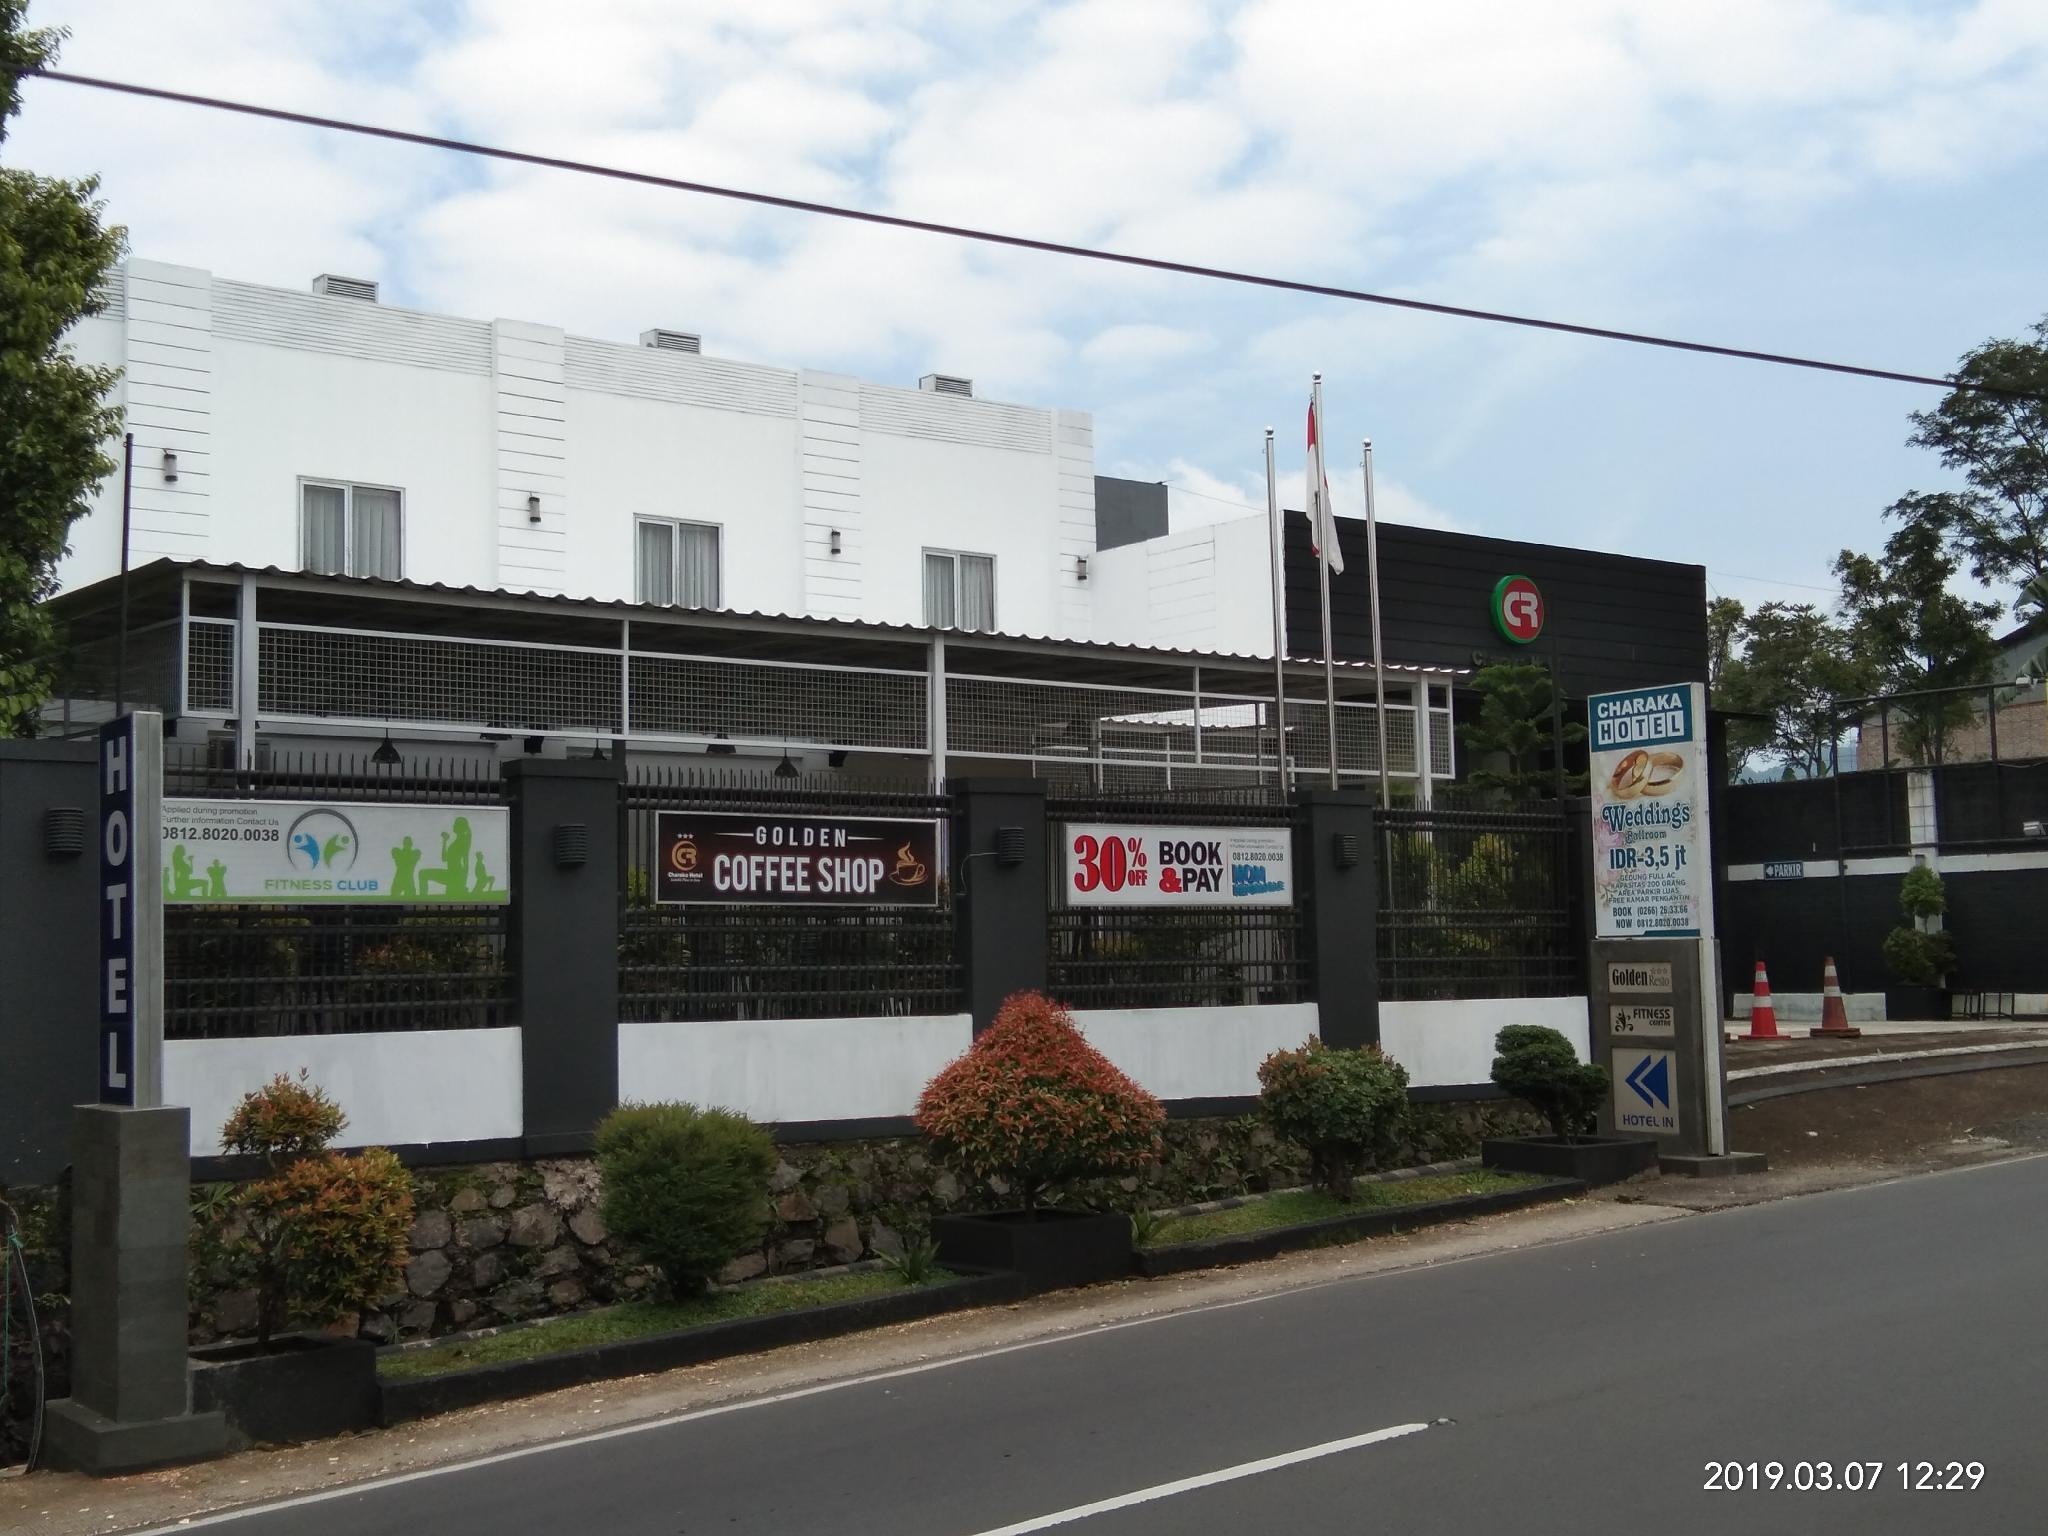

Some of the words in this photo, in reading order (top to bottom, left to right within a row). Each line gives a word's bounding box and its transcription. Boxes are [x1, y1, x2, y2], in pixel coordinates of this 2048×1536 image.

[1597, 693, 1683, 719] CHARAKA
[1600, 714, 1681, 741] HOTEL
[193, 807, 218, 815] during
[1602, 803, 1690, 832] Weddings
[192, 816, 235, 824] information
[237, 817, 266, 825] Contact
[268, 818, 280, 826] Us
[756, 826, 846, 848] GOLDEN
[1159, 841, 1223, 866] BOOK
[1674, 844, 1687, 870] jt
[713, 855, 811, 891] COFFEE
[818, 857, 884, 892] SHOP
[1128, 869, 1147, 887] OFF
[1774, 863, 1802, 877] PARKIR
[265, 879, 332, 891] FITNESS
[336, 880, 379, 891] CLUB
[1618, 889, 1636, 897] AREA
[106, 736, 128, 1089] HOTEL
[1612, 906, 1633, 917] BOOK
[1615, 918, 1633, 929] NOW
[1612, 969, 1648, 987] Golden
[1633, 1008, 1671, 1020] FITNESS
[1622, 1114, 1659, 1128] HOTEL
[1662, 1115, 1674, 1129] IN
